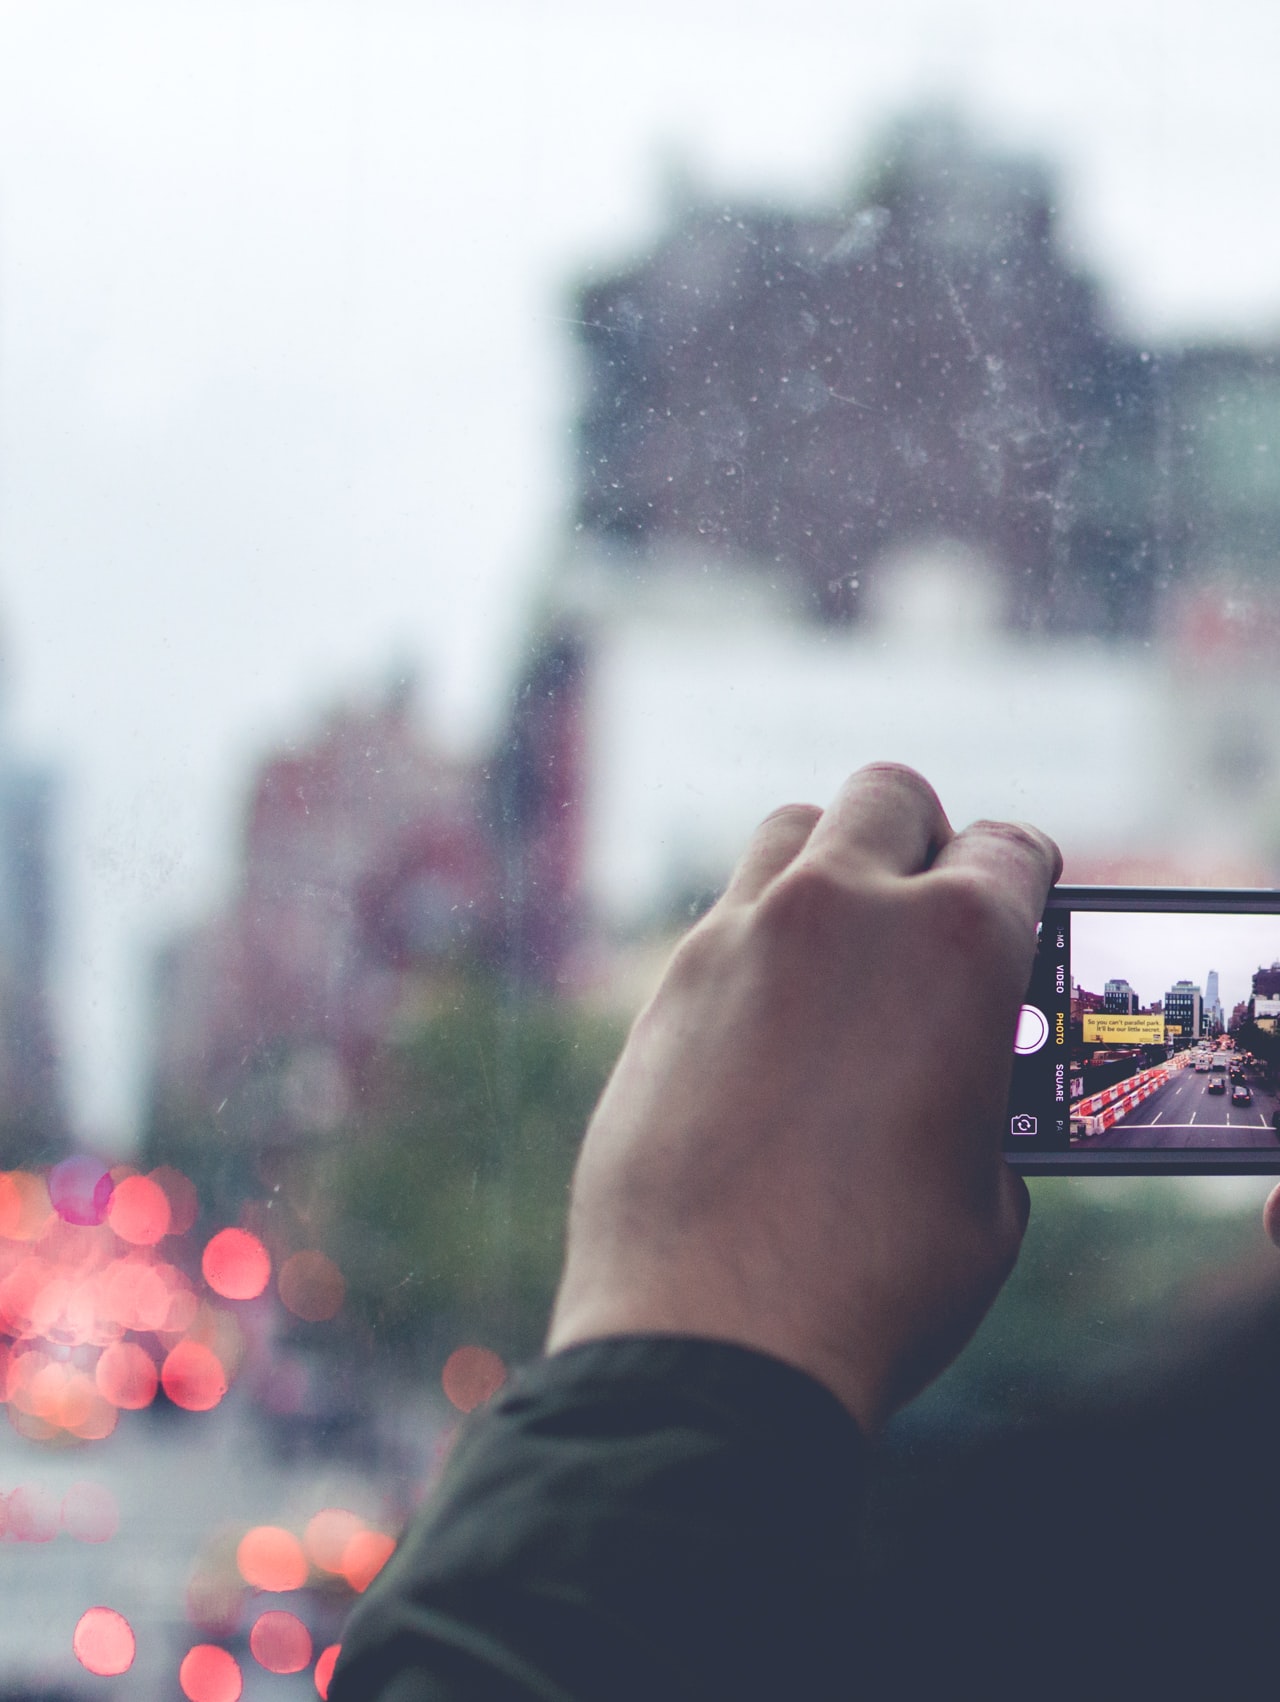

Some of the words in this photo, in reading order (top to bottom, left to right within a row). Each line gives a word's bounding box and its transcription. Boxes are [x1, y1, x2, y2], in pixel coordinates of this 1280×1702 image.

[1056, 964, 1064, 994] VIDEO
[1056, 1012, 1064, 1044] PHOTO
[1056, 1064, 1064, 1102] SQUARE
